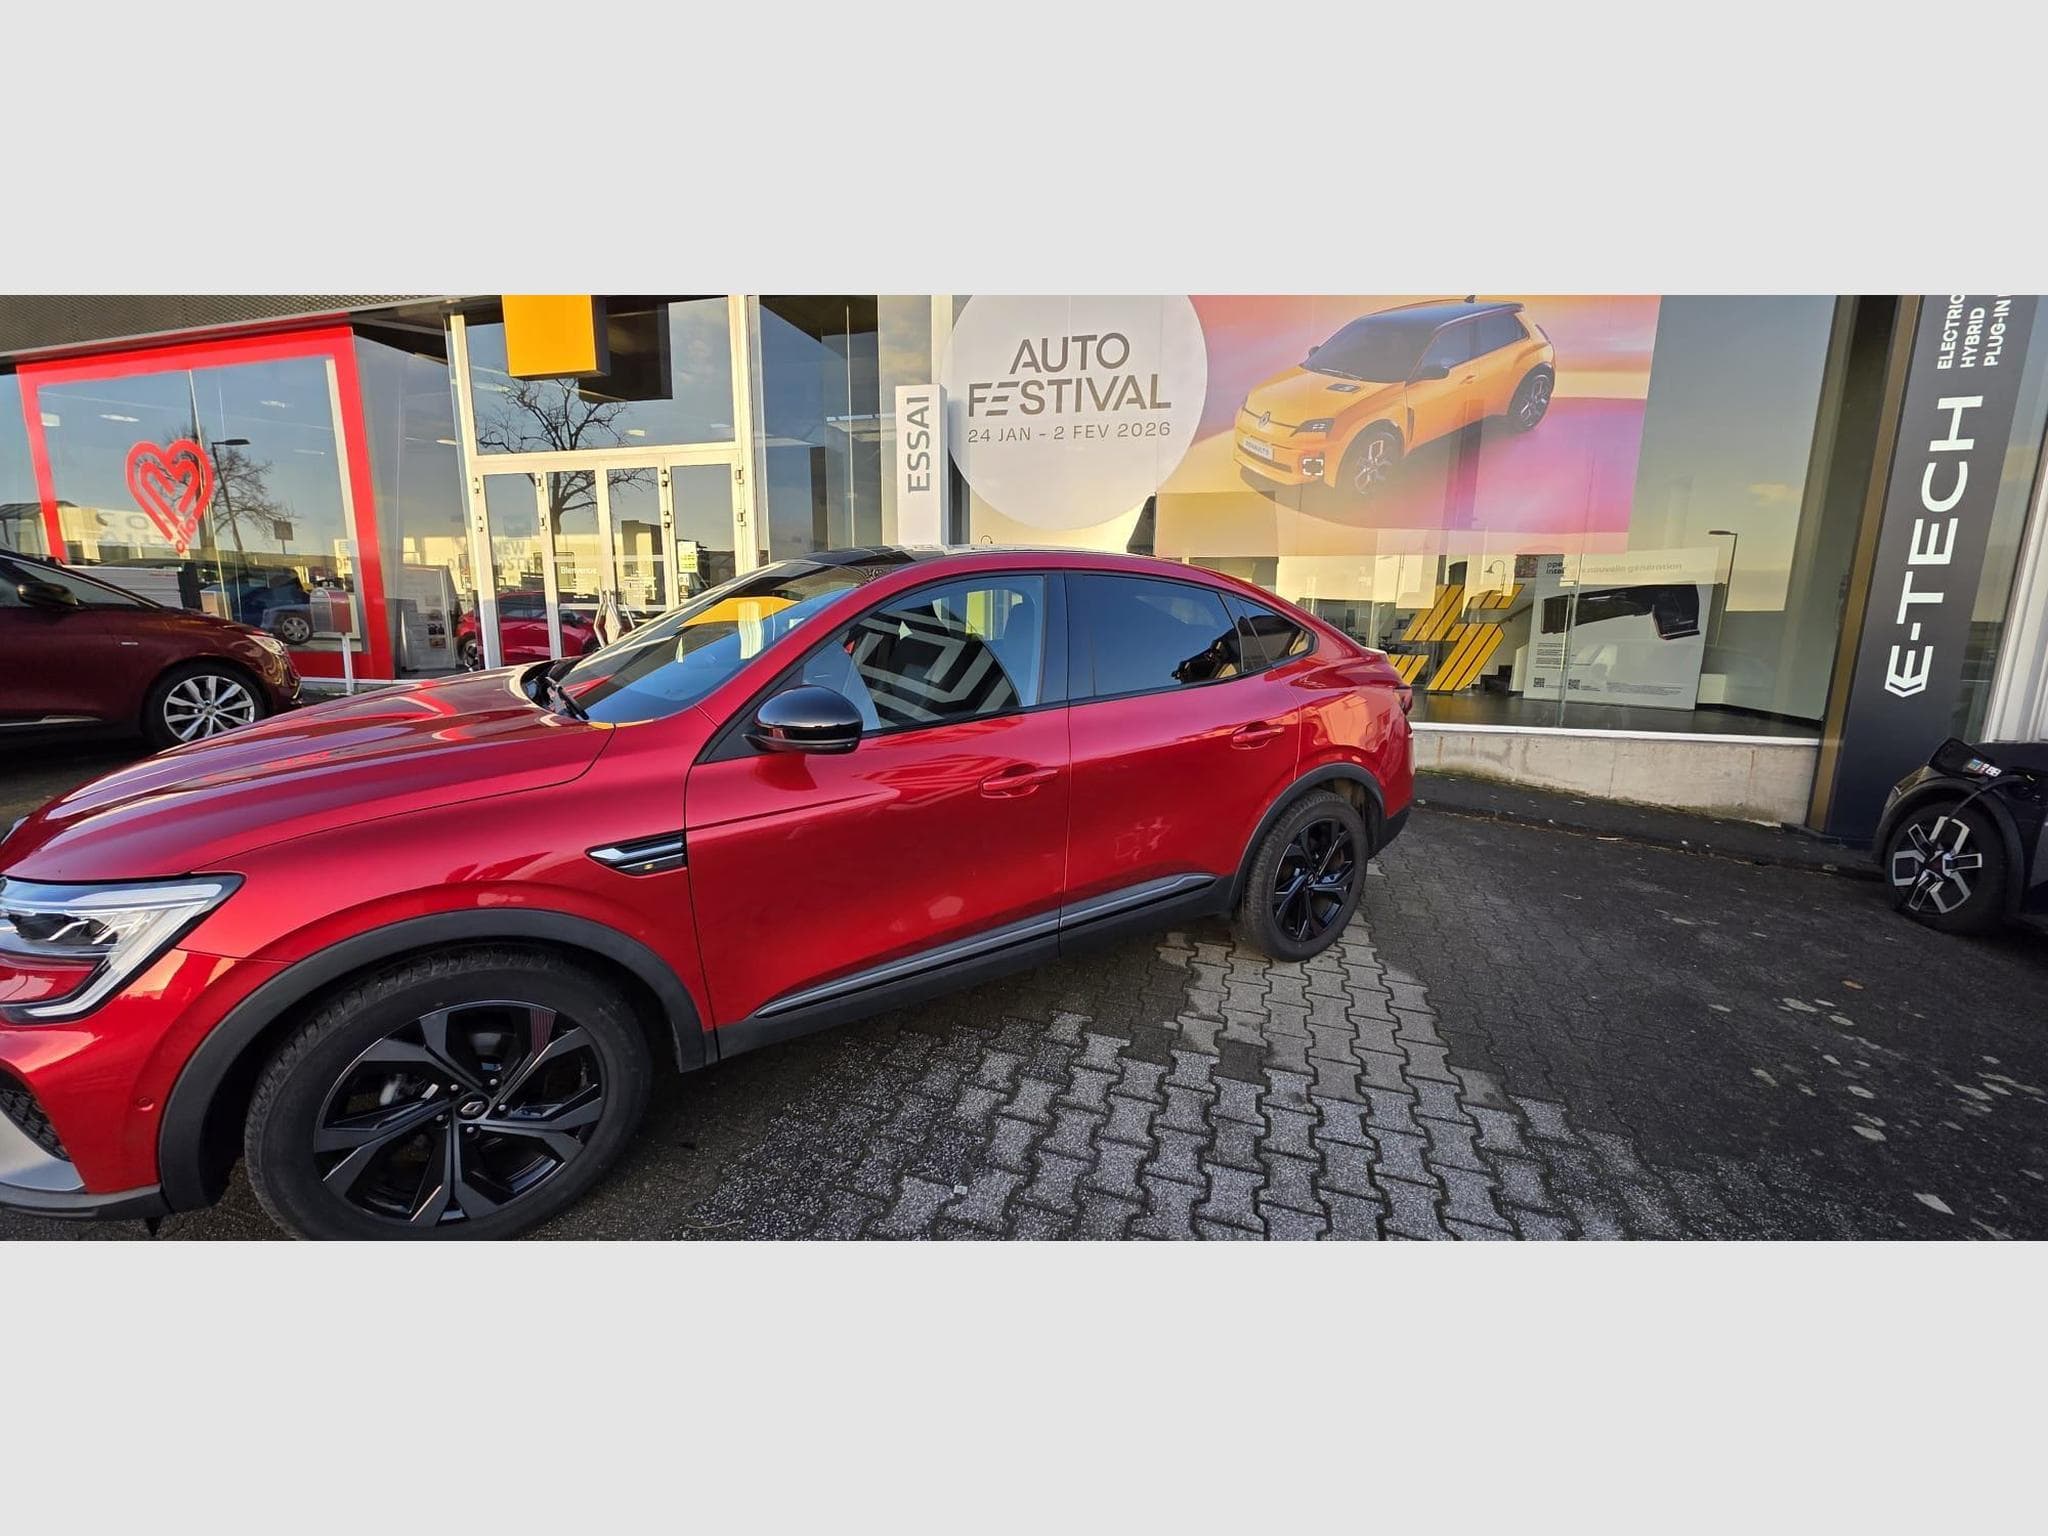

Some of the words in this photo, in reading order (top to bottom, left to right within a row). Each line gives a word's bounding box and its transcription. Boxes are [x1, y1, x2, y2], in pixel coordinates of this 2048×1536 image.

[1009, 333, 1130, 375] AUTO
[1960, 307, 1985, 368] HYBRID
[1983, 299, 2012, 366] PLUG-IN
[968, 374, 1172, 417] FESTIVAL
[906, 396, 930, 493] ESSAI
[967, 429, 991, 443] 24
[998, 427, 1031, 442] JAN
[1053, 425, 1065, 440] 2
[1073, 424, 1110, 439] FEV
[1117, 421, 1171, 438] 2026
[1884, 395, 1983, 698] E-TECH
